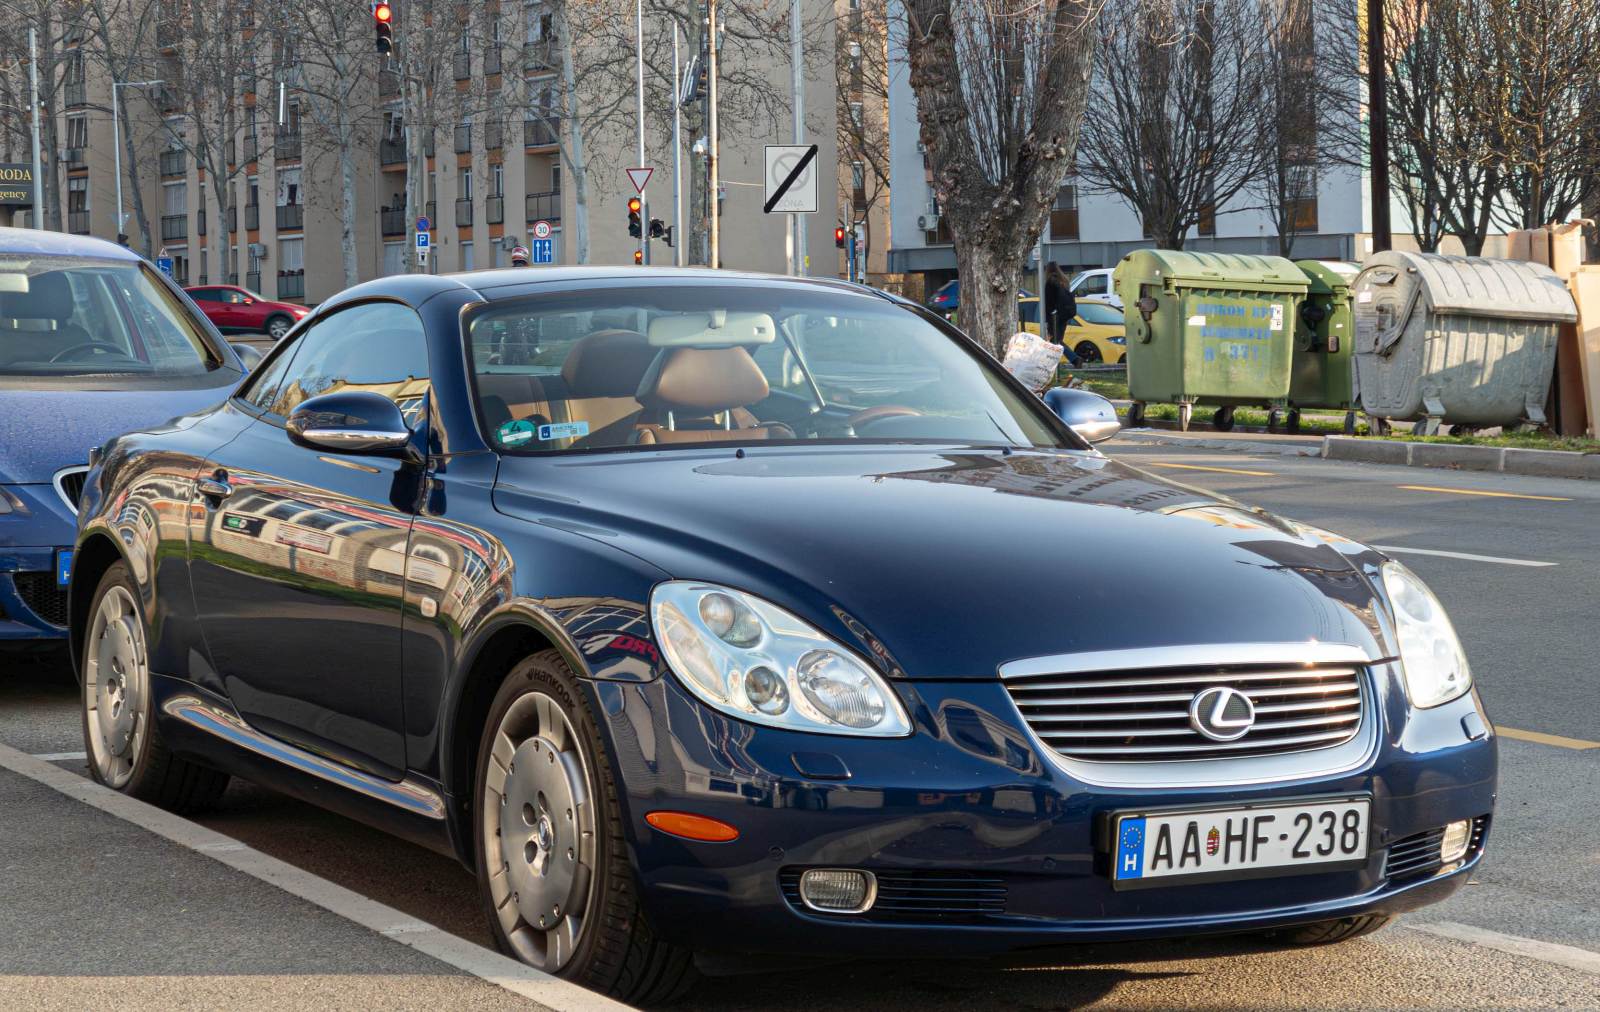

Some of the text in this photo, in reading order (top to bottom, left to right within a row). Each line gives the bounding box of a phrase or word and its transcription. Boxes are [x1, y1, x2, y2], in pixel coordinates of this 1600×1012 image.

[537, 226, 548, 234] 30
[419, 235, 427, 246] P
[1124, 853, 1137, 871] H
